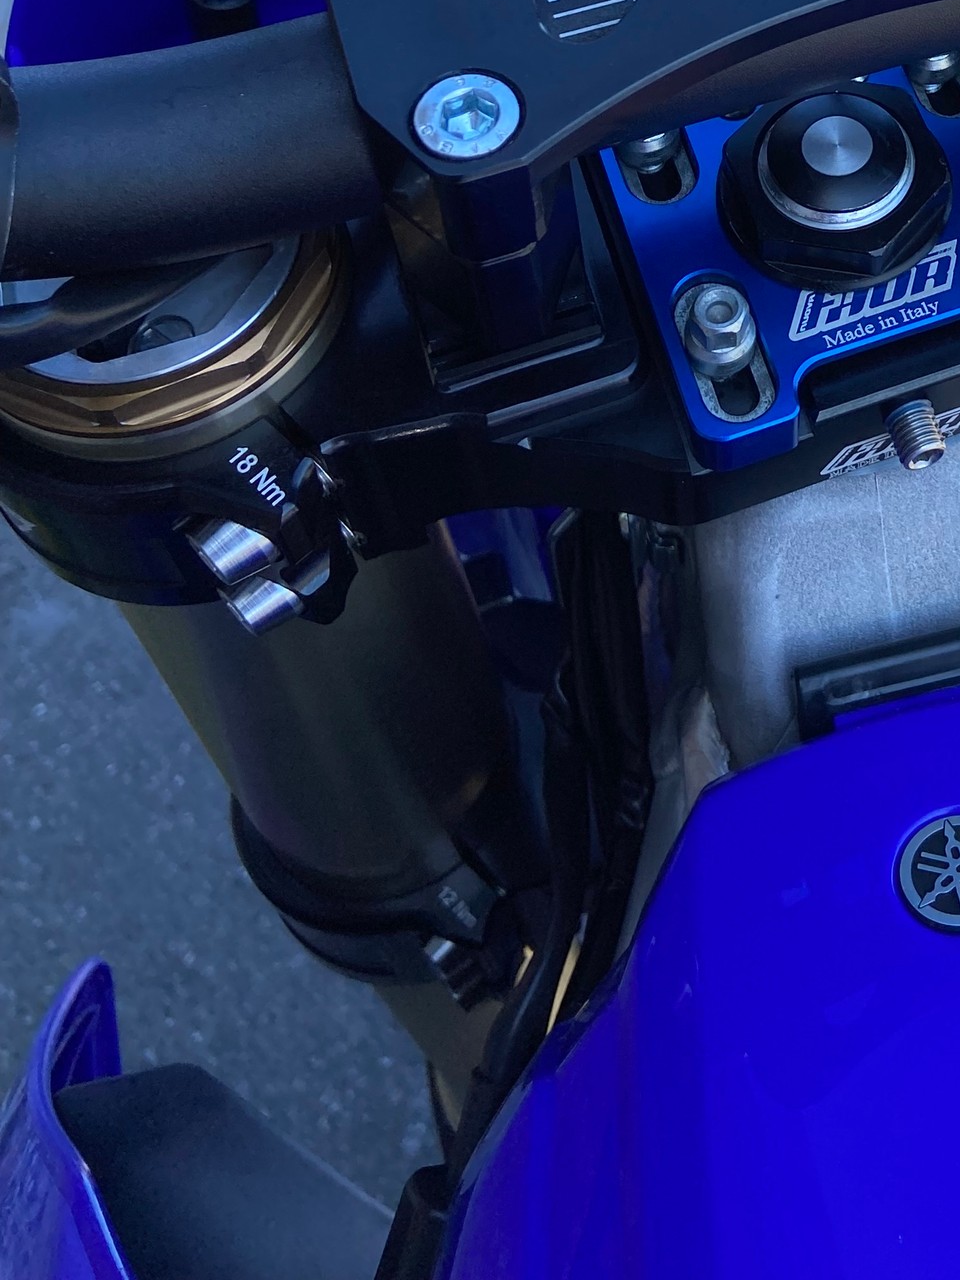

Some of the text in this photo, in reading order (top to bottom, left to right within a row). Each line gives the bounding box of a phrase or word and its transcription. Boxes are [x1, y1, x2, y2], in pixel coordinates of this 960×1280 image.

[822, 300, 940, 349] Made in Italy
[228, 446, 286, 507] 18 Nm
